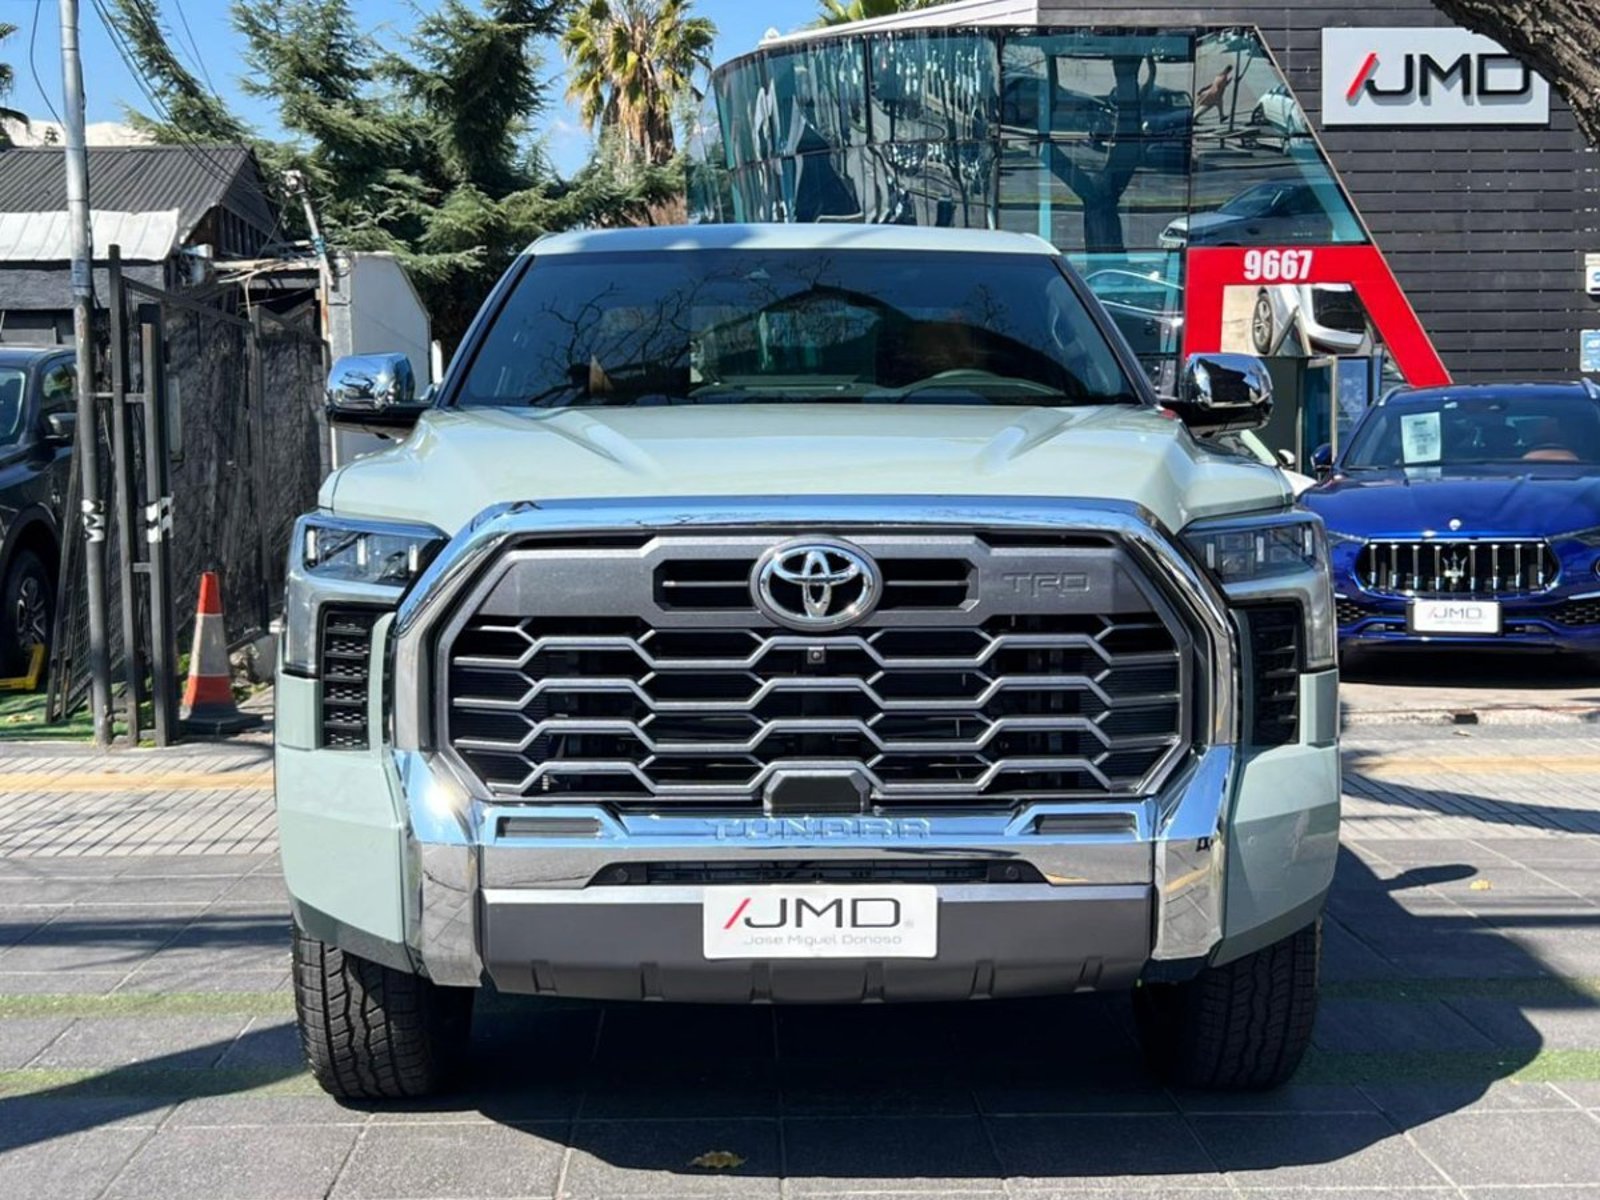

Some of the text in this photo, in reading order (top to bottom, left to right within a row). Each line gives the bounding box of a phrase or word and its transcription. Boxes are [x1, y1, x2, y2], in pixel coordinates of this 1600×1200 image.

[1365, 53, 1531, 97] JMD
[1243, 249, 1313, 281] 9667
[1001, 571, 1090, 597] TRD
[704, 815, 931, 840] TUNDRA
[743, 897, 901, 929] JMD
[787, 933, 837, 948] Miguel
[841, 933, 903, 946] Donoso
